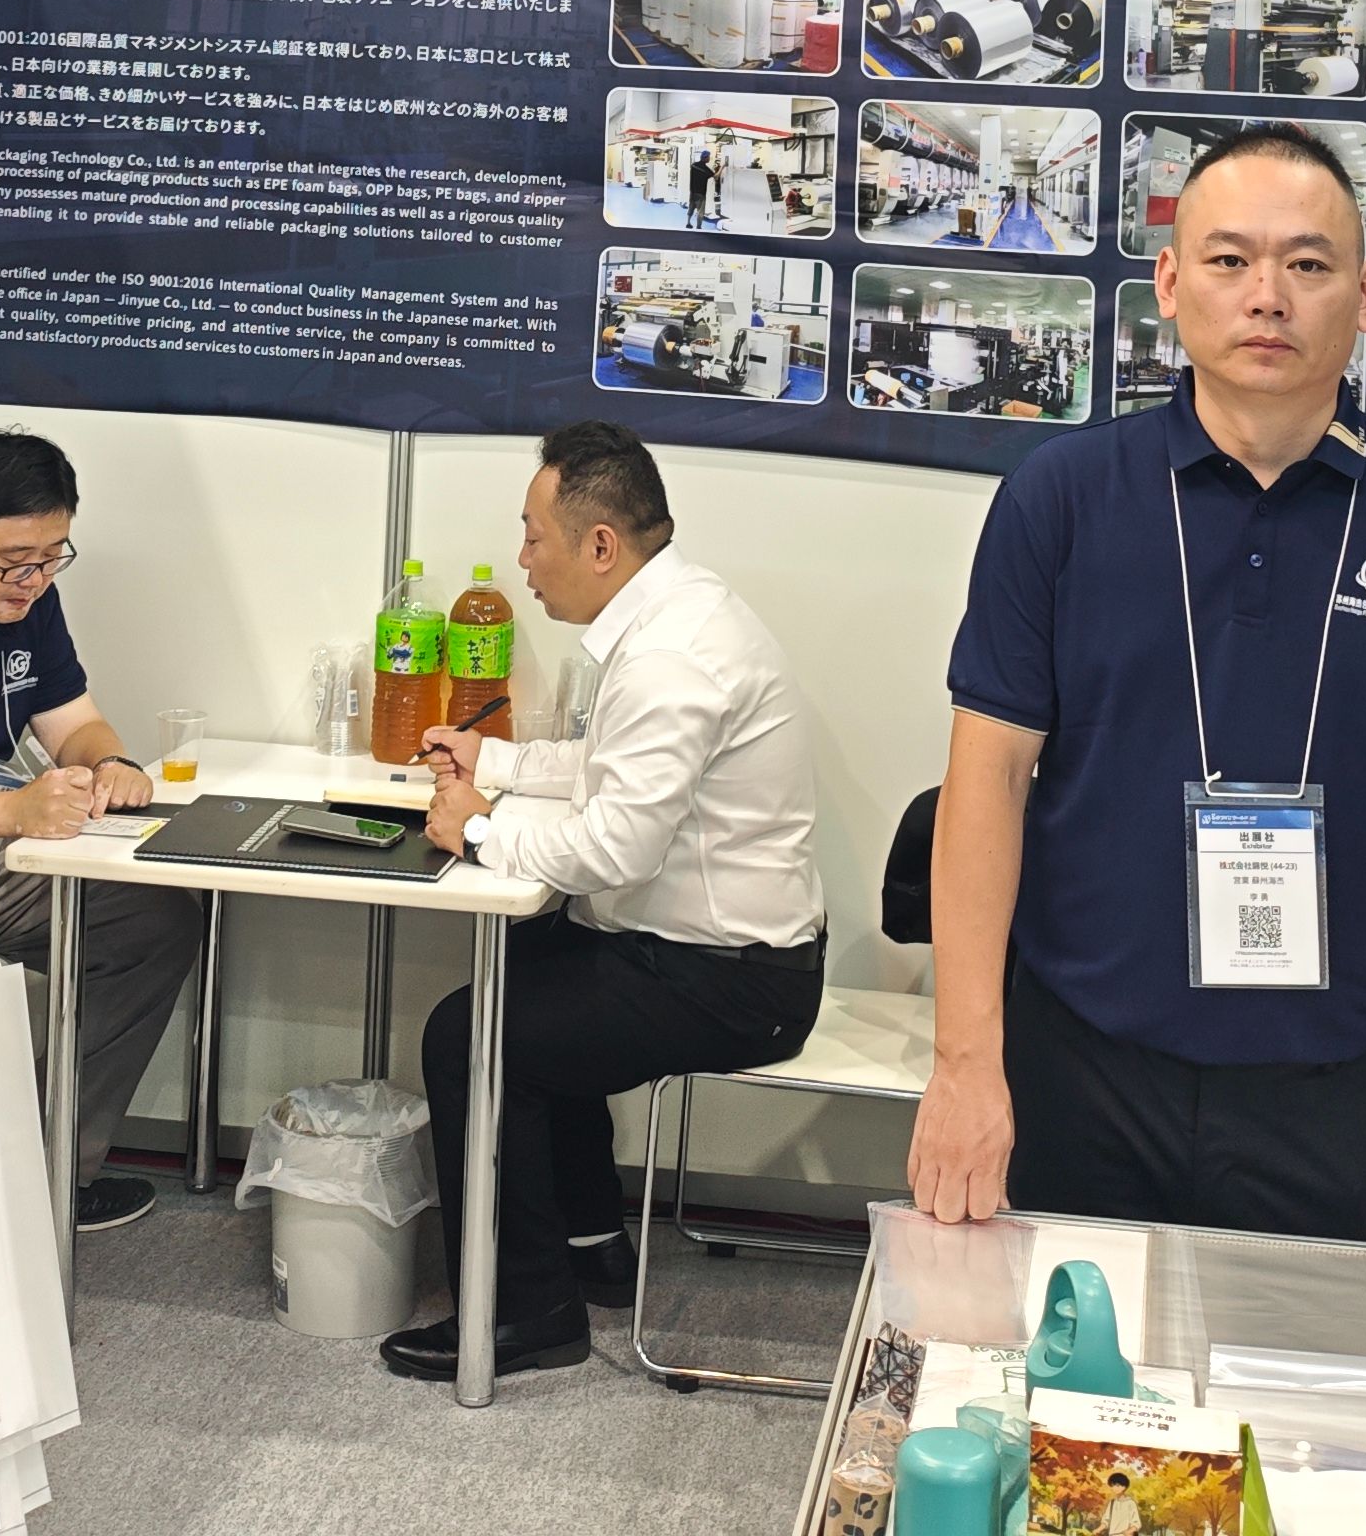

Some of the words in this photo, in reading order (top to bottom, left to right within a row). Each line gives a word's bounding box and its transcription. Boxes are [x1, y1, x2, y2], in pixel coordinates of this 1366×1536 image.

[51, 152, 124, 168] Technology
[126, 155, 152, 168] Co.,
[155, 156, 180, 167] Ltd.
[184, 157, 195, 168] is
[198, 159, 214, 169] an
[217, 159, 283, 173] enterprise
[287, 162, 314, 173] that
[317, 163, 381, 178] integrates
[384, 166, 406, 178] the
[410, 169, 470, 183] research,
[474, 170, 566, 187] development,
[52, 271, 90, 282] under
[95, 273, 116, 284] the
[121, 274, 144, 285] ISO
[149, 276, 213, 289] 9001:2016
[219, 280, 302, 295] International
[308, 285, 355, 301] Quality
[361, 288, 445, 304] Management
[450, 293, 498, 307] System
[503, 297, 529, 308] and
[534, 297, 558, 310] has
[990, 1349, 1028, 1363] clea
